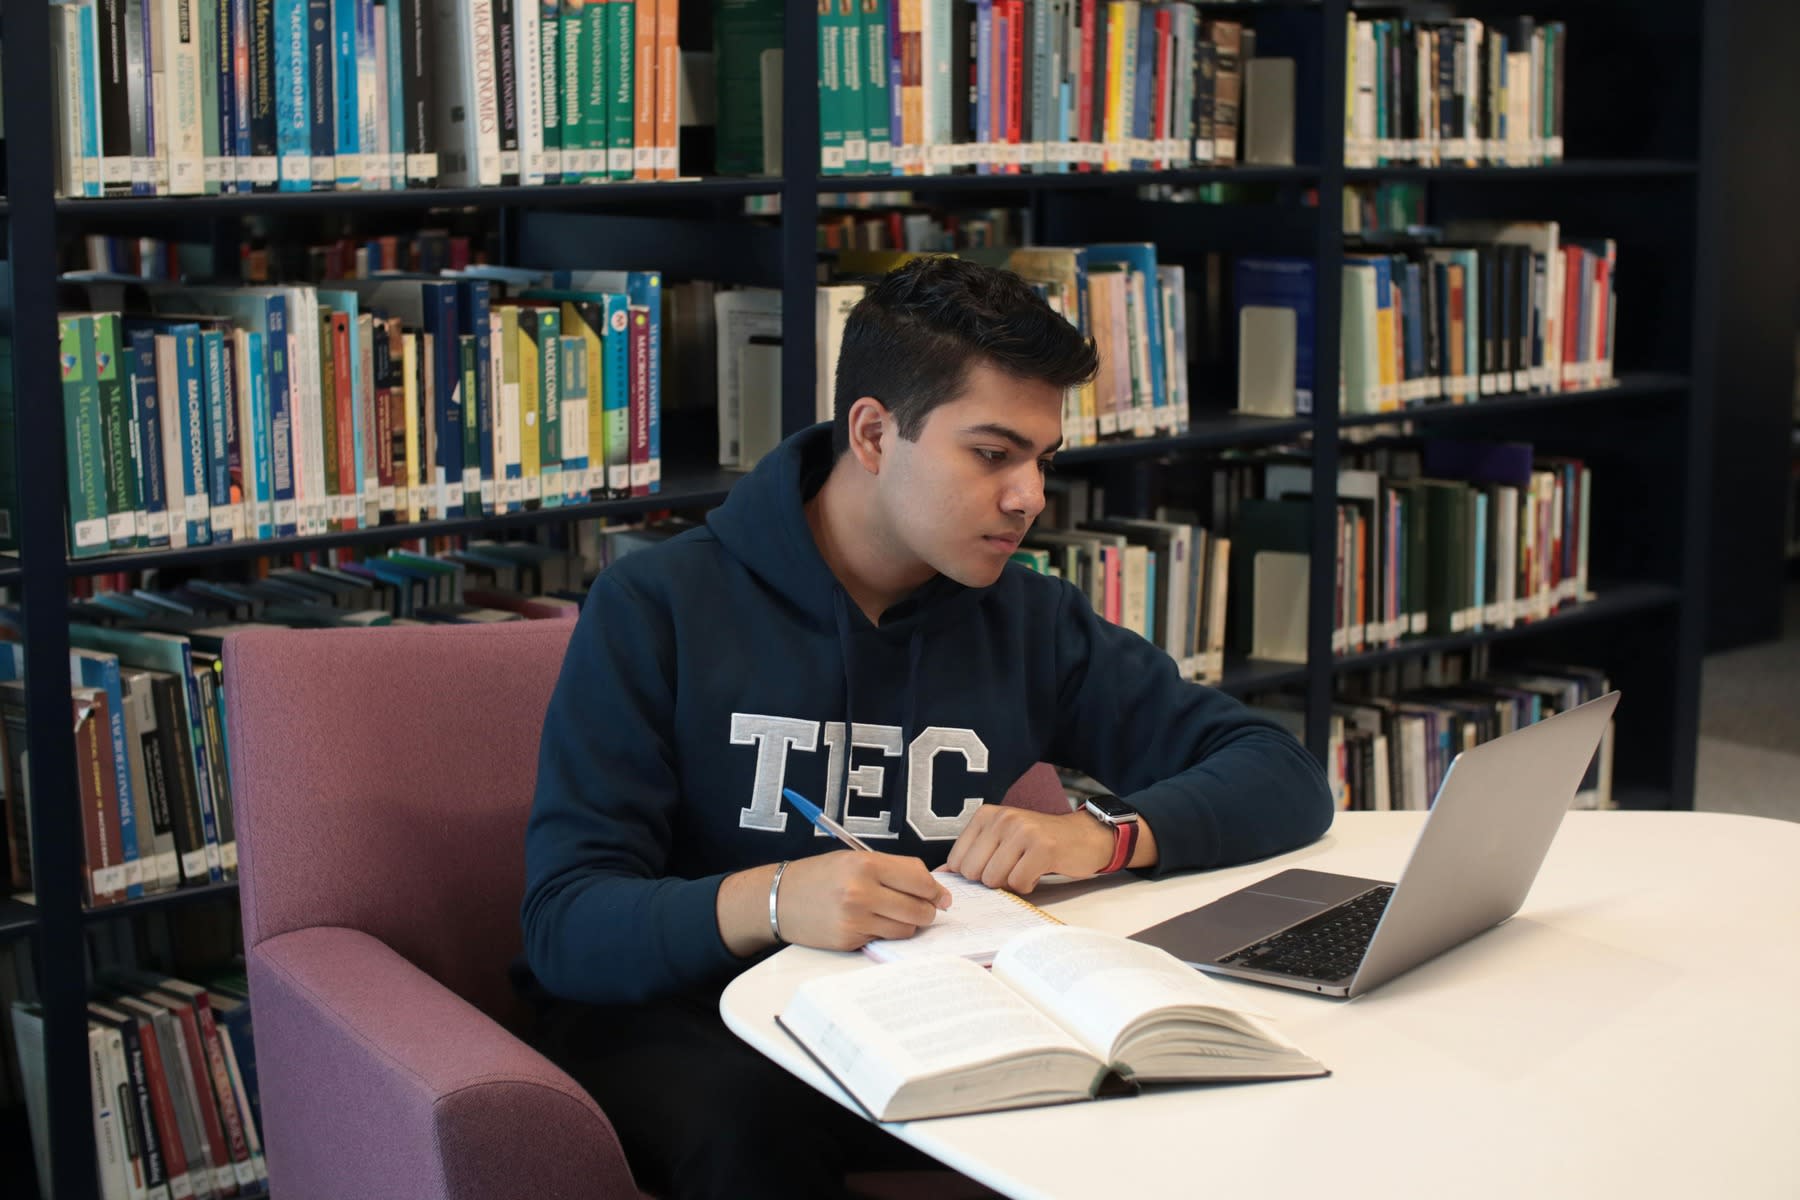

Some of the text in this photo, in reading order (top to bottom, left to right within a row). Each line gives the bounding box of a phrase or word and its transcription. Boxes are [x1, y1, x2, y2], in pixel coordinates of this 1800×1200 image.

[473, 1, 496, 135] MACROECONOMICS
[500, 23, 515, 131] MACROECONOMICS
[617, 5, 630, 103] Macroeconomía
[110, 385, 128, 509] MACROECONOMÍ
[636, 335, 647, 449] MACROECONOMÍA
[730, 713, 989, 841] TEC
